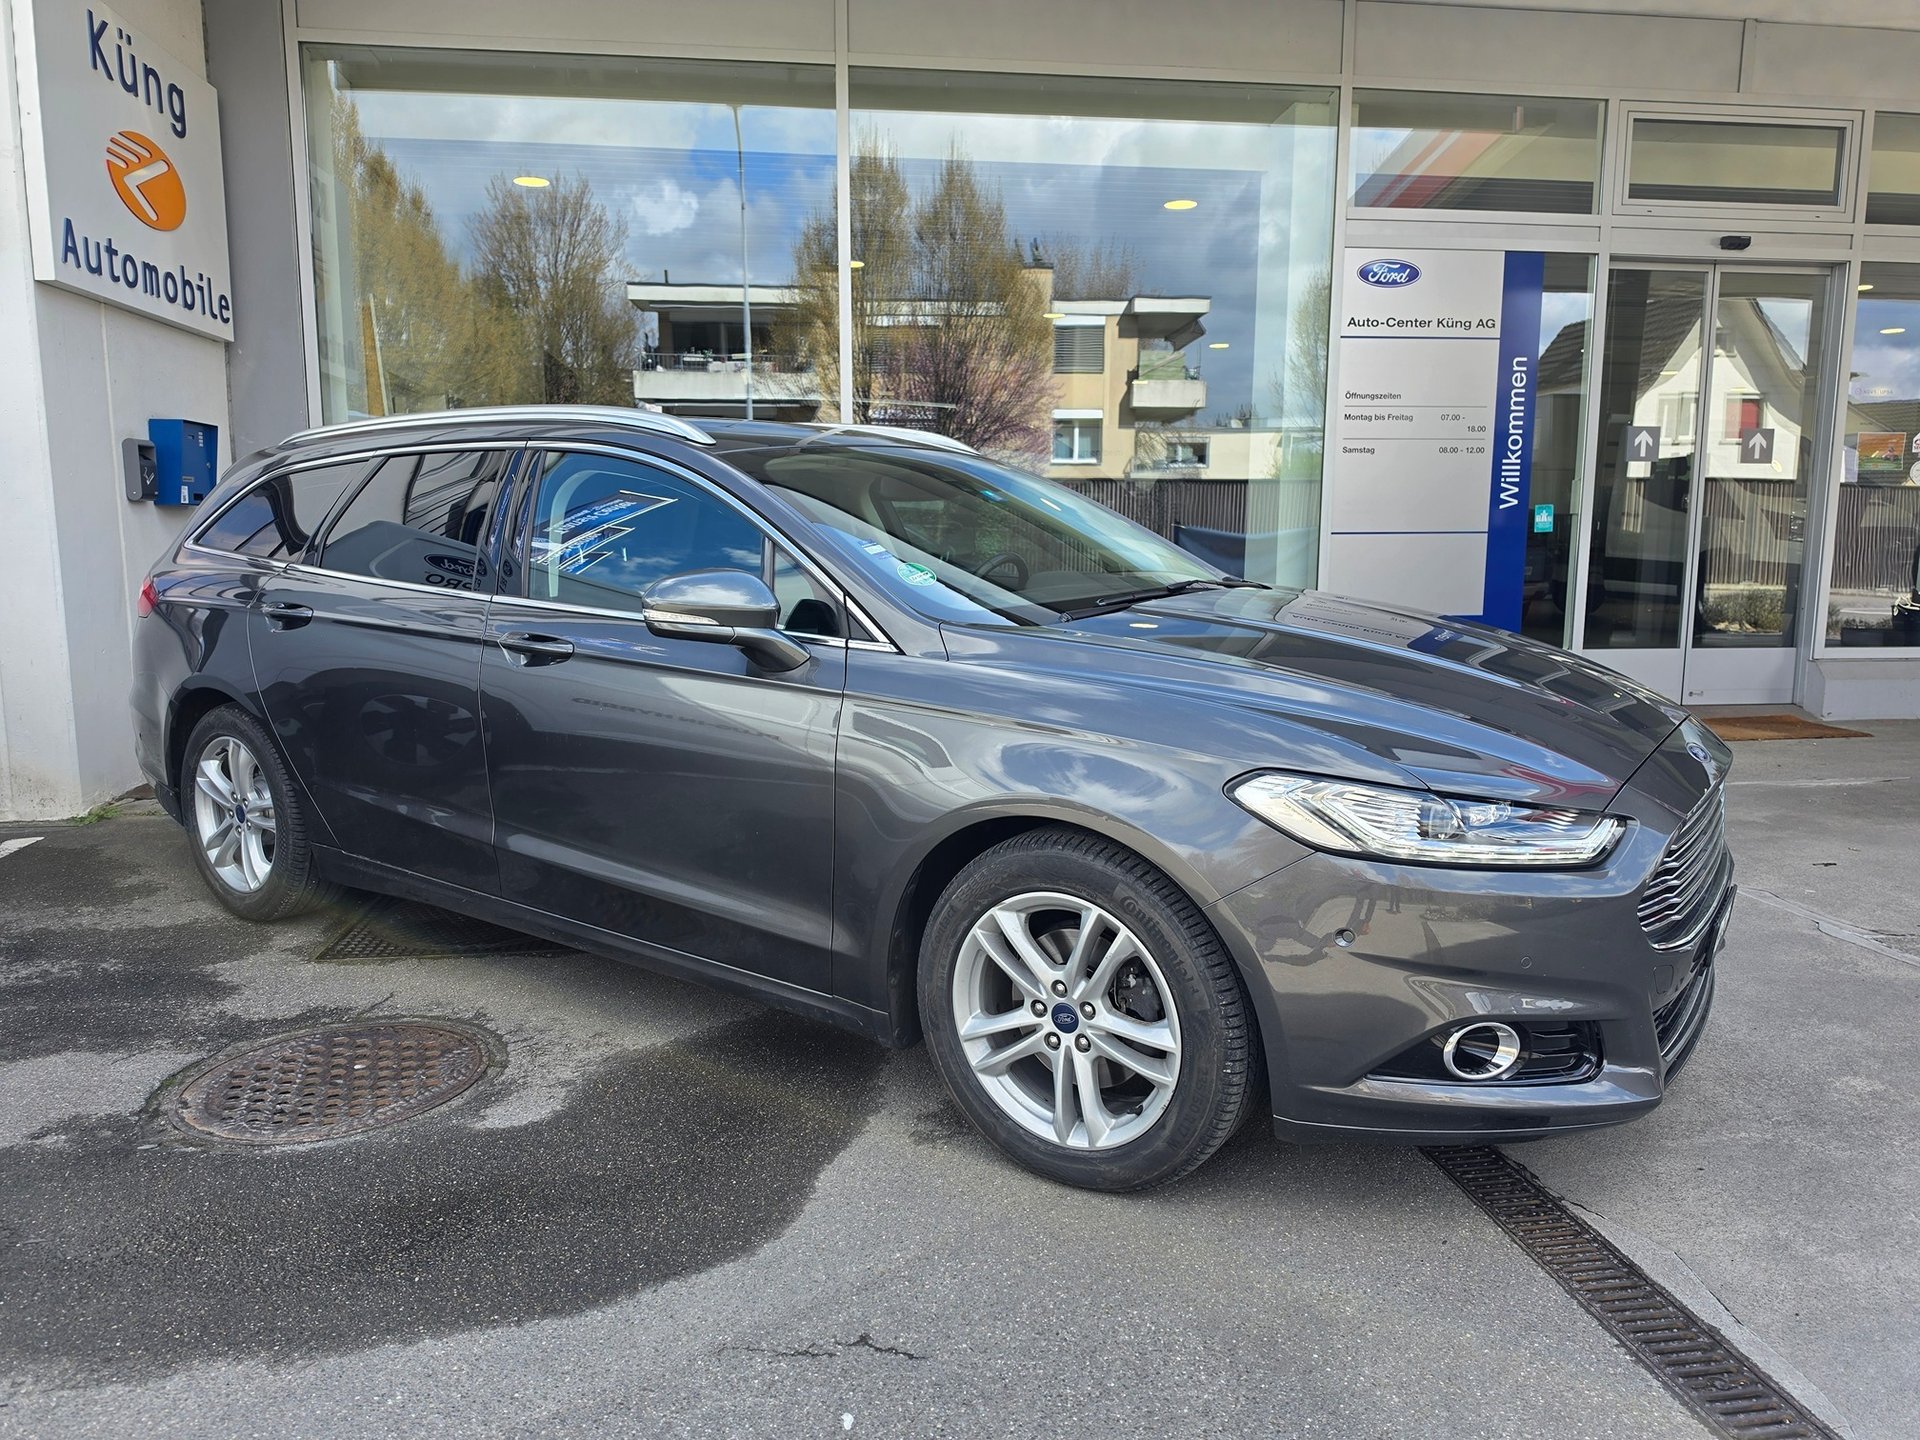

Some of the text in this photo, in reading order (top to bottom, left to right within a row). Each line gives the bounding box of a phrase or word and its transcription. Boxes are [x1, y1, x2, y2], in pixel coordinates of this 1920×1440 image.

[86, 8, 186, 138] Küng
[62, 217, 232, 325] Automobile
[1367, 262, 1410, 283] Ford
[1347, 317, 1496, 331] Auto-Center Küng AG
[1345, 391, 1401, 401] Öffnungszeiten
[1344, 413, 1373, 422] Montag
[1374, 413, 1386, 421] bis
[1387, 413, 1414, 422] Freitag
[1467, 425, 1487, 433] 18.00
[1499, 356, 1528, 509] Willkommen
[1342, 446, 1375, 455] Samstag
[1439, 446, 1459, 454] 08.00
[1466, 446, 1485, 454] 12.00
[1119, 894, 1195, 984] Continental
